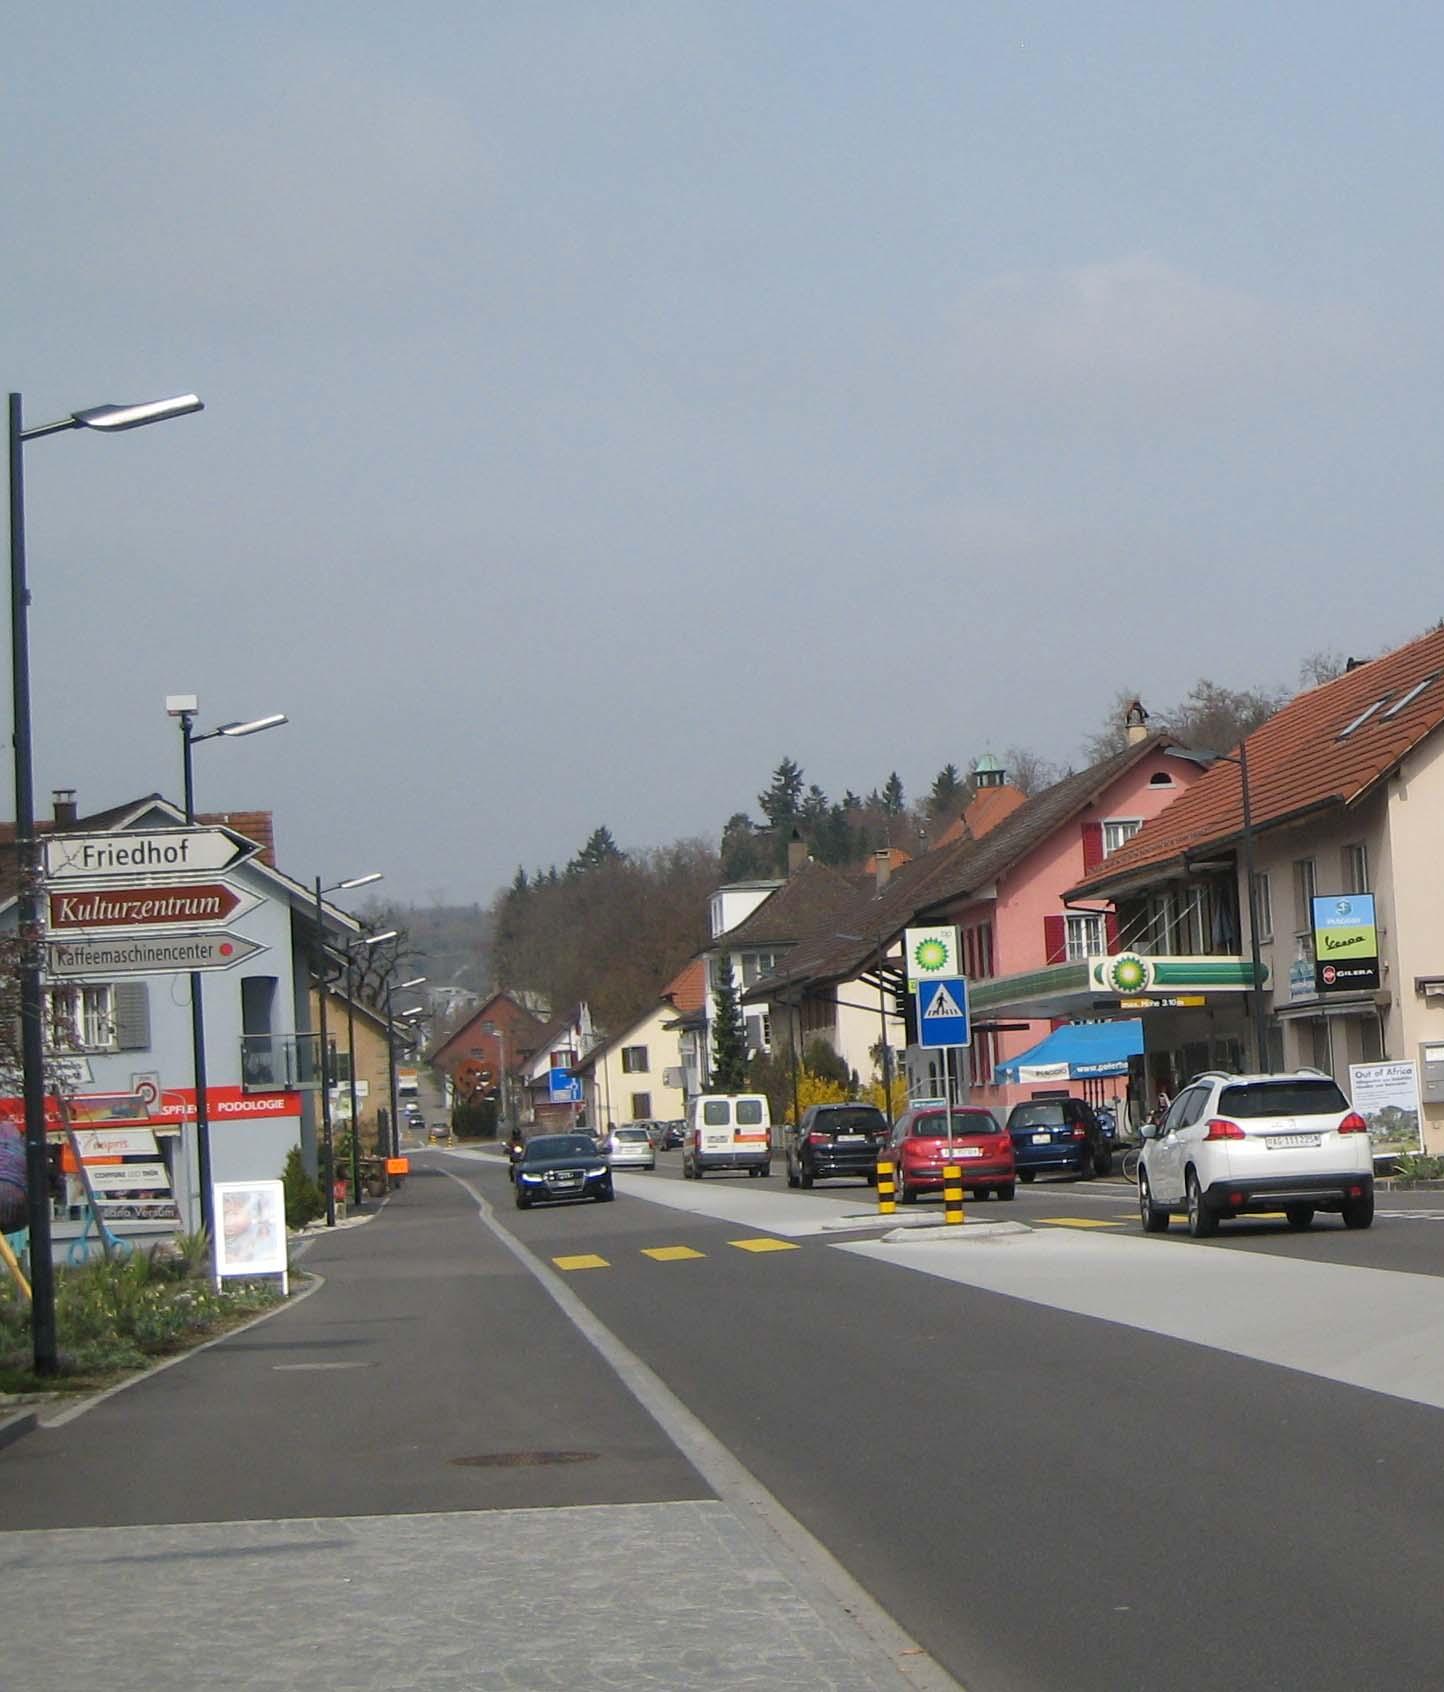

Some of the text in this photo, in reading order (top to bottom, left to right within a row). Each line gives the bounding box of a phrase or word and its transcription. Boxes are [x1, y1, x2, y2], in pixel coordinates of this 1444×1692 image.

[83, 838, 189, 868] Friedhof
[59, 895, 221, 923] Kulturzentrum
[1324, 935, 1367, 951] Vespa
[57, 943, 214, 967] Kaffeemaschinencenter
[1336, 969, 1374, 978] GILERA
[1355, 1067, 1413, 1079] Out of Africa
[217, 1099, 286, 1113] PODOLOGIE
